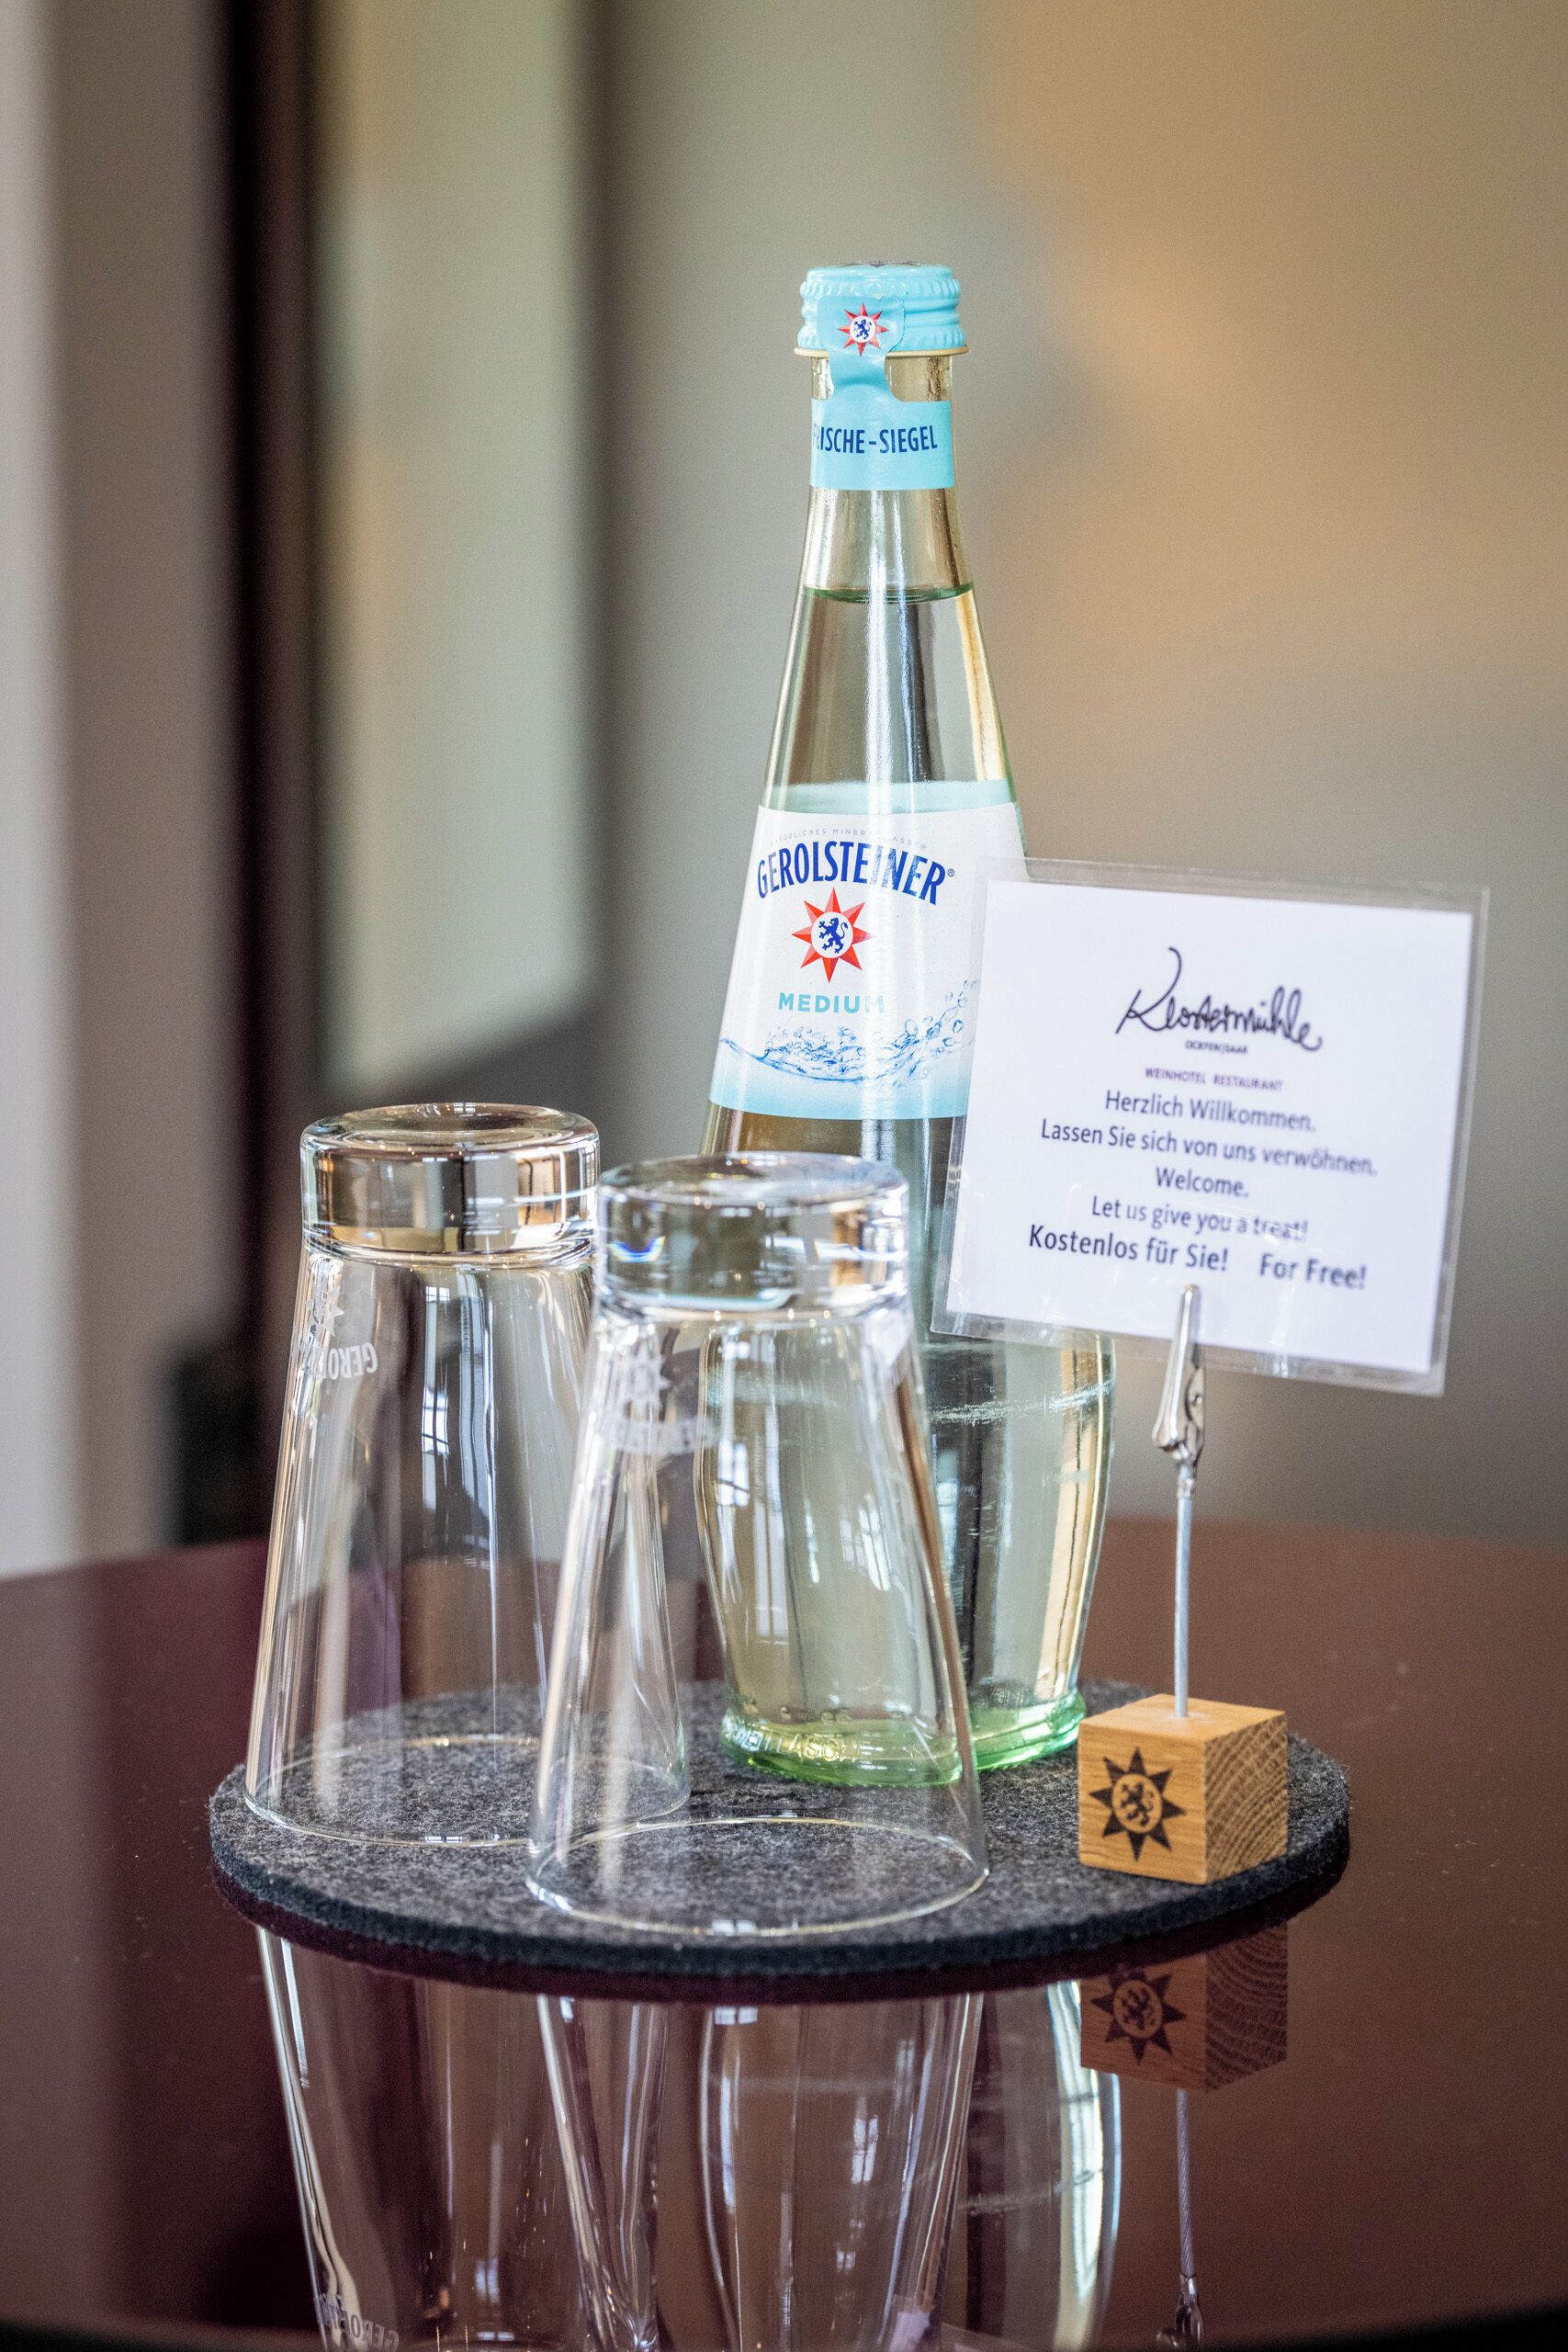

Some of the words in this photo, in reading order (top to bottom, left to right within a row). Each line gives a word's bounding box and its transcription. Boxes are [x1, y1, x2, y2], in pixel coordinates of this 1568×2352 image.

[778, 991, 886, 1013] MEDIUM
[1114, 945, 1323, 1052] Klostermühle
[1145, 1068, 1206, 1084] WEINHOTEL
[1213, 1073, 1283, 1091] RESTAURANT
[1105, 1090, 1183, 1117] Herzlich
[1190, 1099, 1315, 1132] Willkommen.
[1042, 1118, 1102, 1145] Lassen
[1108, 1125, 1135, 1148] Sie
[1141, 1130, 1177, 1153] sich
[1183, 1139, 1217, 1158] von
[1223, 1145, 1256, 1162] uns
[1261, 1148, 1377, 1176] verwöhnen.
[1156, 1167, 1248, 1198] Welcome.
[1092, 1195, 1121, 1219] Let
[1126, 1203, 1147, 1222] us
[1152, 1204, 1191, 1230] give
[1195, 1211, 1232, 1235] you
[1236, 1217, 1247, 1234] a
[1253, 1216, 1308, 1241] treat!
[1029, 1224, 1138, 1261] Kostenlos
[1145, 1237, 1179, 1265] für
[1185, 1243, 1228, 1272] Sie!
[1259, 1252, 1299, 1280] For
[1305, 1258, 1367, 1290] Free!
